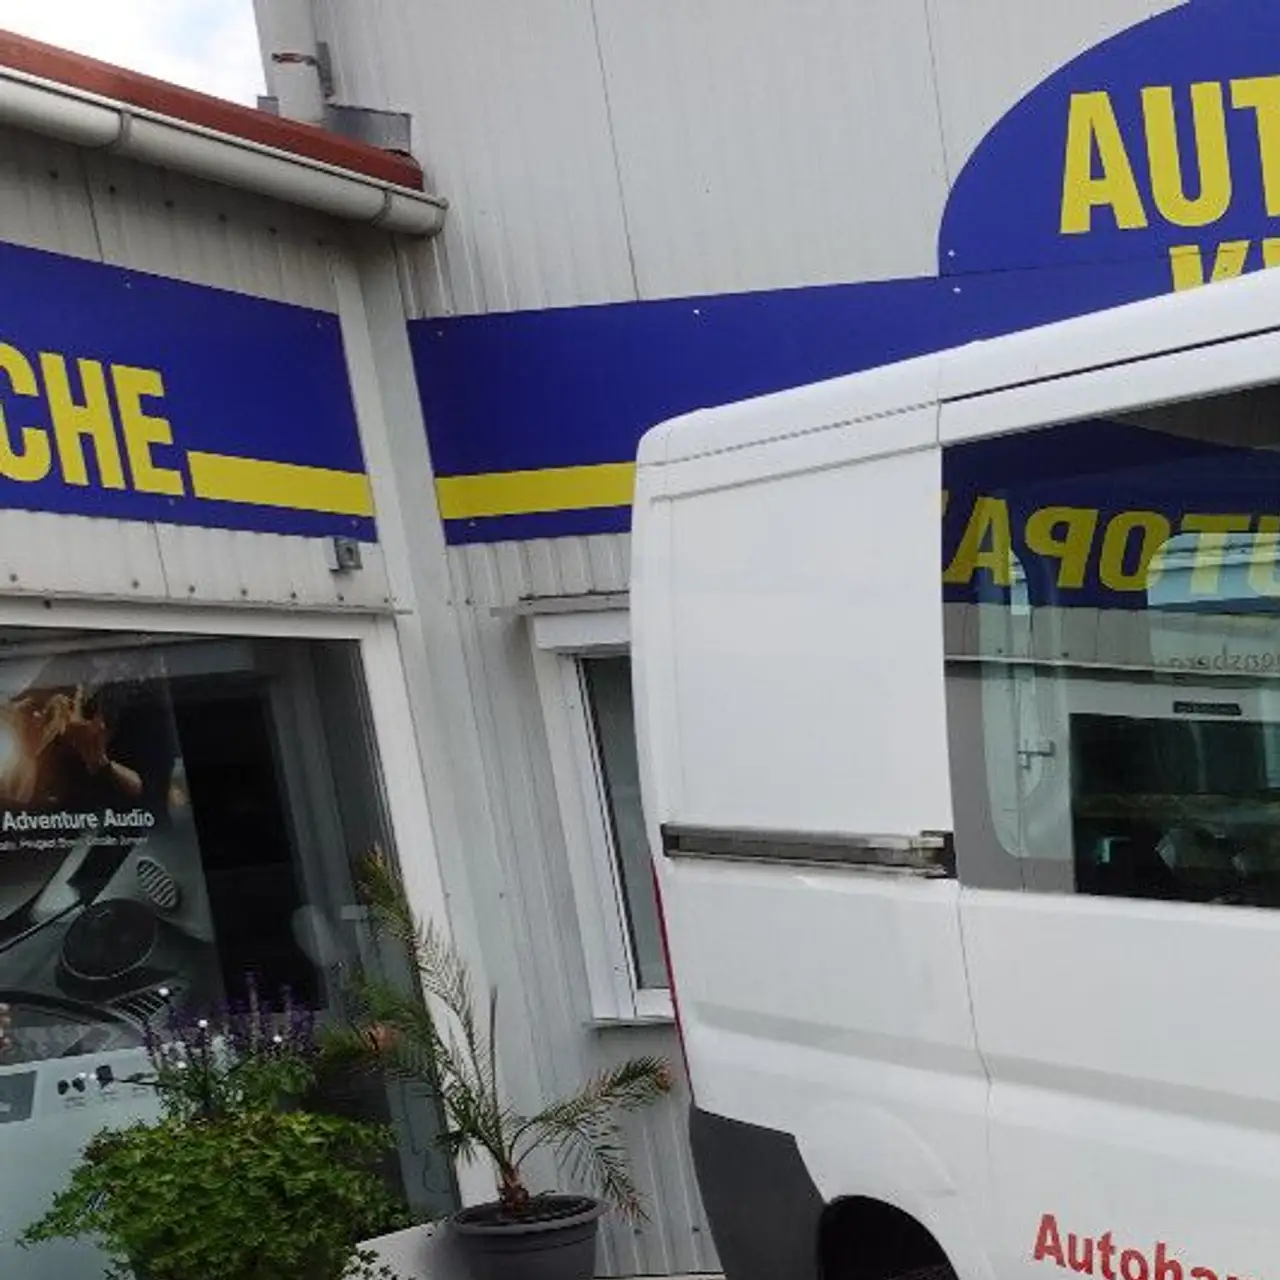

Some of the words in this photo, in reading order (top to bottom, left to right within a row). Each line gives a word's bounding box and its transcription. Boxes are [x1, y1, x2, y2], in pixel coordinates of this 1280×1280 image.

[0, 342, 184, 496] CHE
[2, 810, 99, 831] Adventure
[103, 808, 156, 827] Audio
